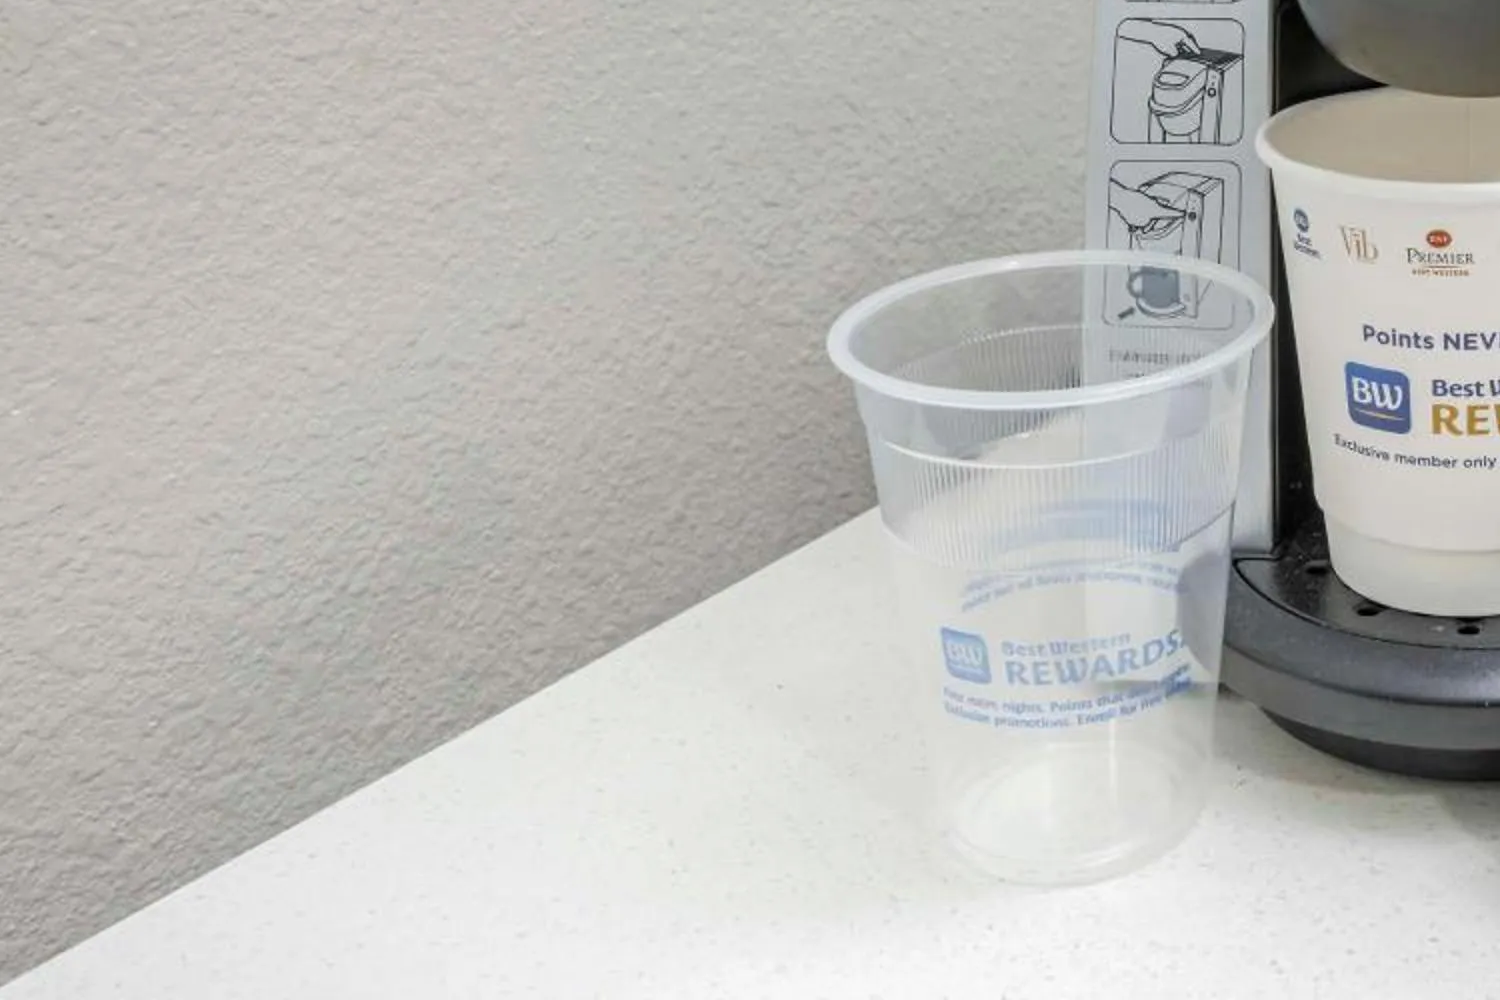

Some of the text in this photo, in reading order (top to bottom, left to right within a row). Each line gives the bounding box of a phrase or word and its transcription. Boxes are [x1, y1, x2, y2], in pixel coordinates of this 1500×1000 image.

[1362, 323, 1435, 351] Points
[1351, 377, 1404, 411] BW
[1431, 378, 1485, 398] Best
[1332, 433, 1391, 462] Exclusive
[1394, 450, 1458, 469] member
[1463, 454, 1498, 471] only
[1001, 632, 1132, 657] Best Western
[1005, 628, 1181, 686] REWARDS
